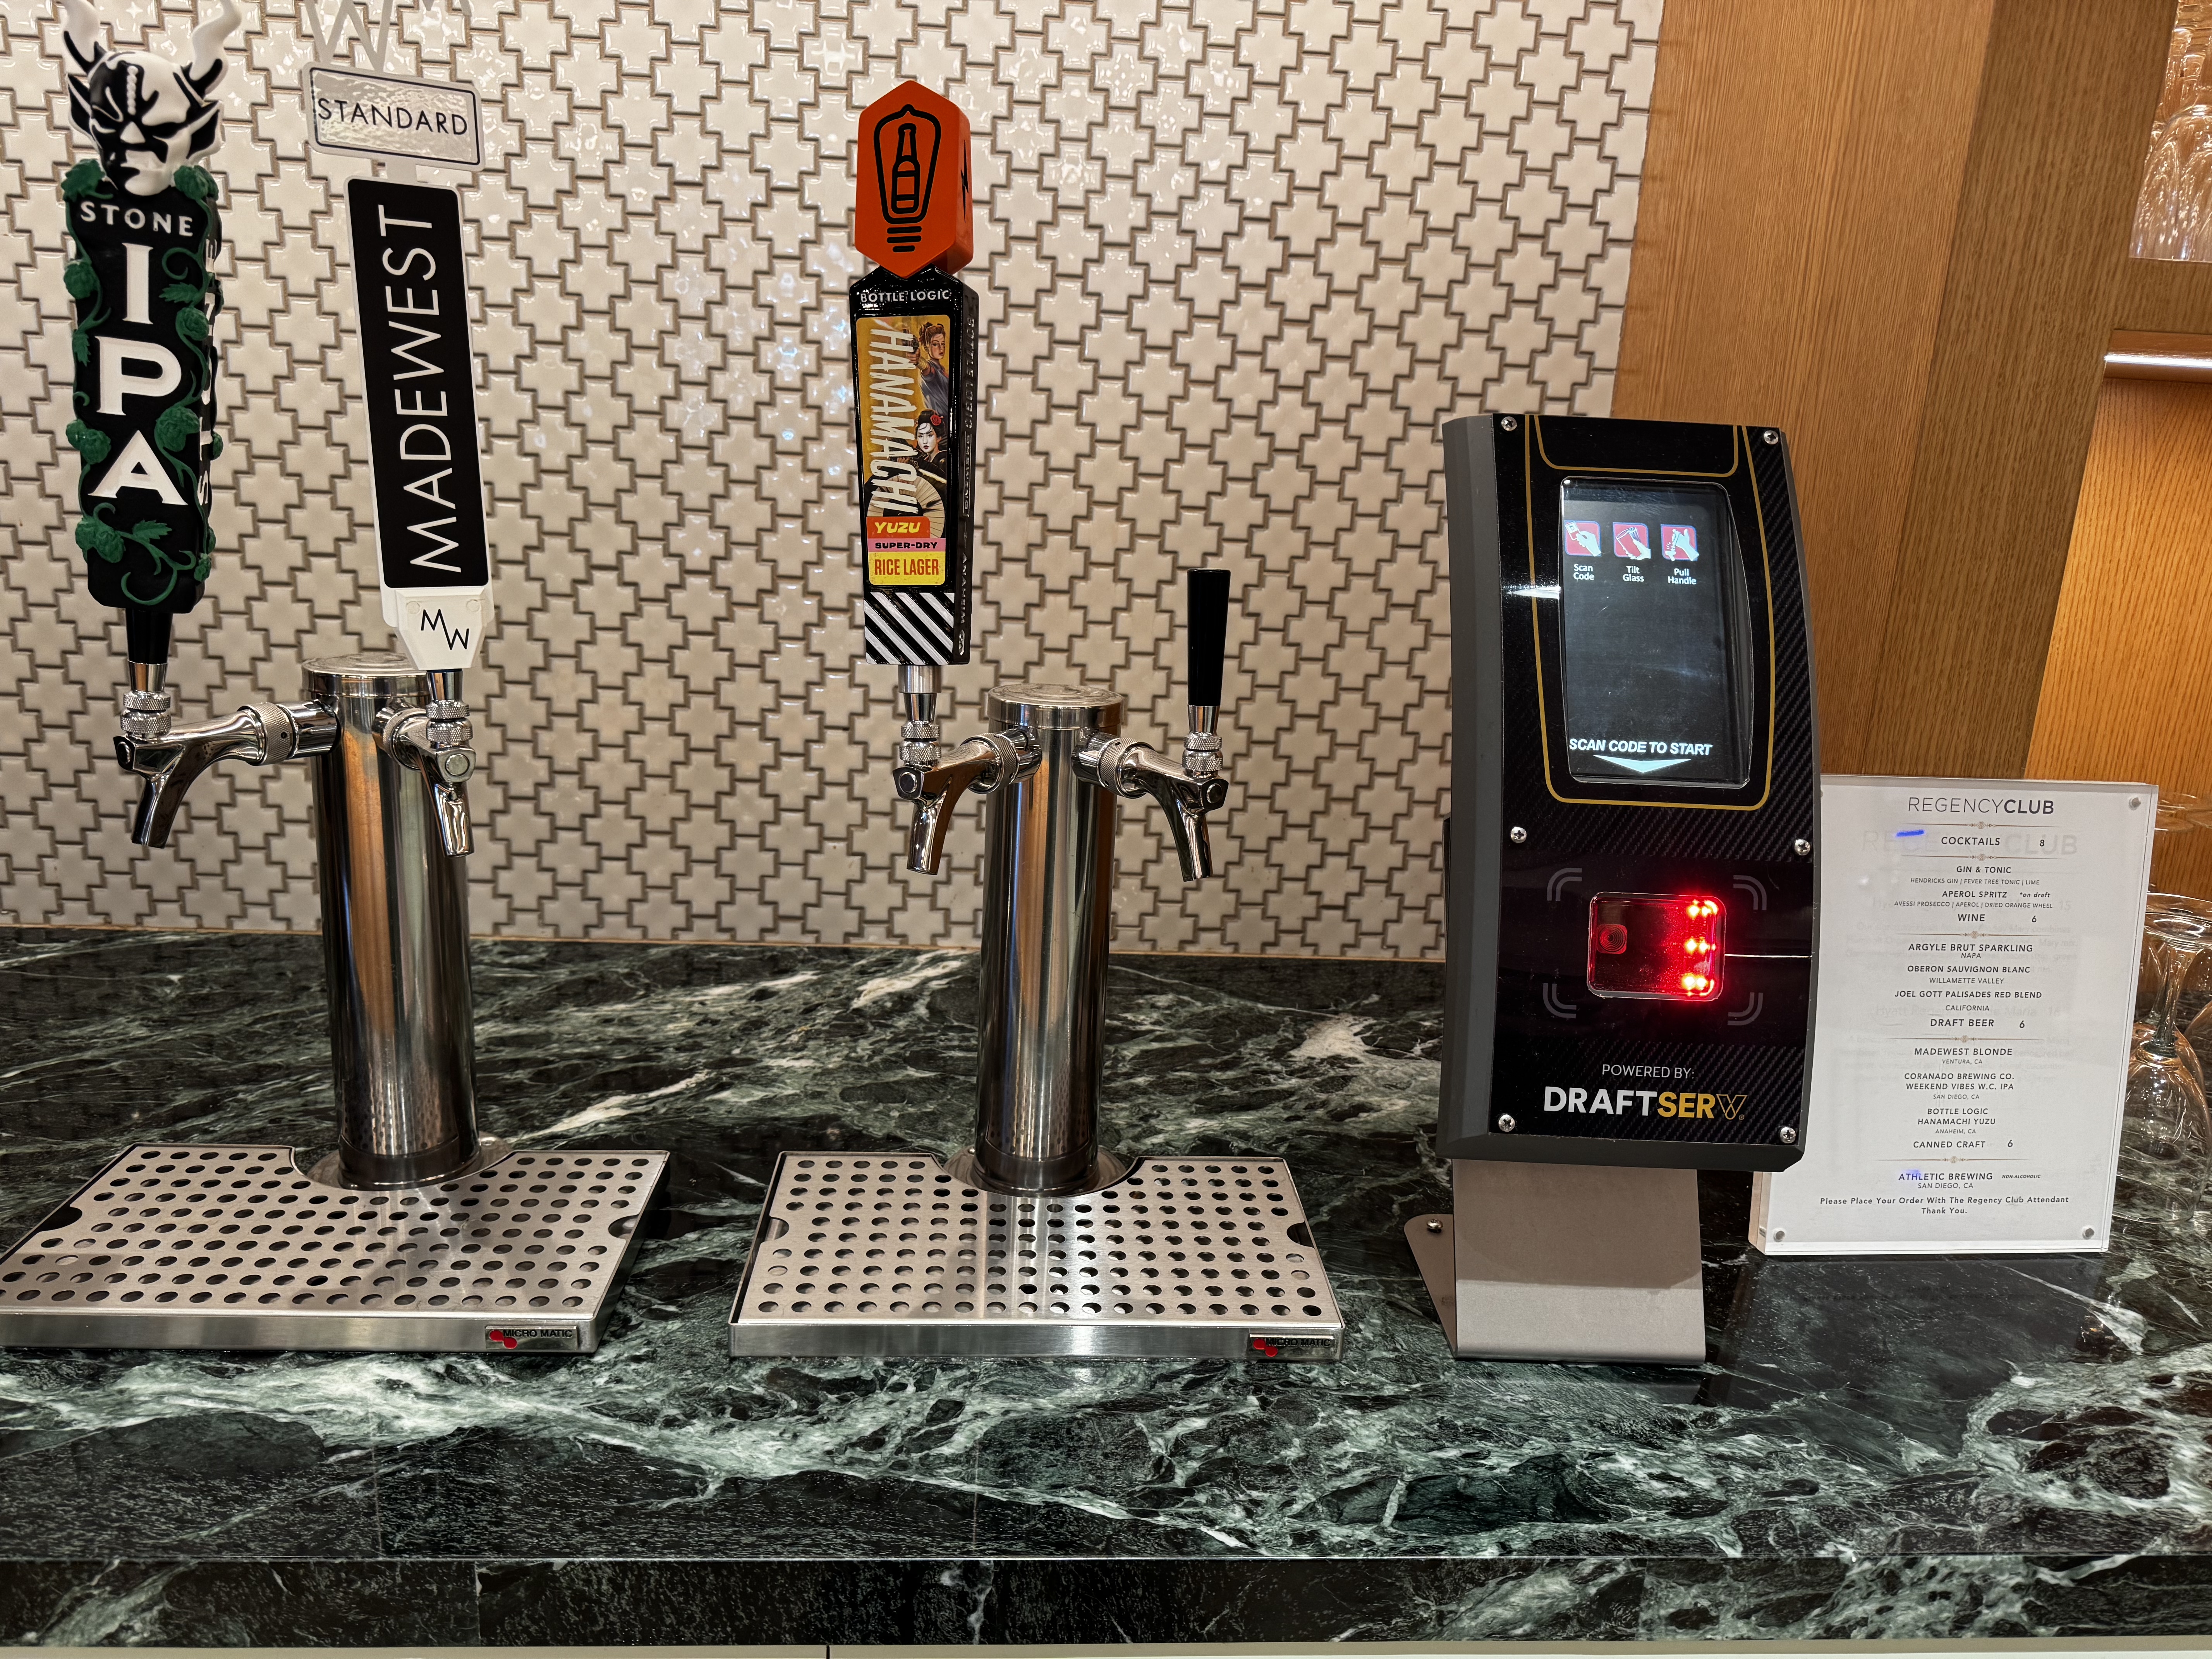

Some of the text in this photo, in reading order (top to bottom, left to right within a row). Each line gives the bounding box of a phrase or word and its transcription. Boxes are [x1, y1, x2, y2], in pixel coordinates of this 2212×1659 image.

[318, 98, 467, 136] STANDARD
[80, 200, 193, 237] STONE
[860, 290, 949, 302] BOTTLE LOGIC
[88, 243, 188, 505] IPA
[378, 204, 461, 573] MADEWEST
[869, 329, 919, 514] HANAMACHI
[874, 522, 921, 533] YUZU
[875, 559, 939, 575] RICE LAGER
[1574, 564, 1593, 572] Scan
[1626, 566, 1640, 574] Tilt
[1573, 572, 1594, 580] Code
[1674, 568, 1689, 577] Pull
[1623, 574, 1644, 582] Glass
[1668, 576, 1697, 585] Handle
[1569, 738, 1713, 756] SCAN CODE TO START
[1908, 797, 2054, 814] REGENCYCLUB
[1941, 836, 2000, 846] COCKTAILS
[1958, 914, 1985, 922] WINE
[1930, 1018, 1965, 1027] DRAFT
[2019, 1020, 2025, 1029] 6
[1602, 1064, 1695, 1079] POWERED BY:
[2008, 1139, 2013, 1147] 6
[1968, 1197, 2002, 1205] Regency
[503, 1329, 573, 1338] MICRO MATIC
[1266, 1338, 1331, 1346] MICRO MATIC
